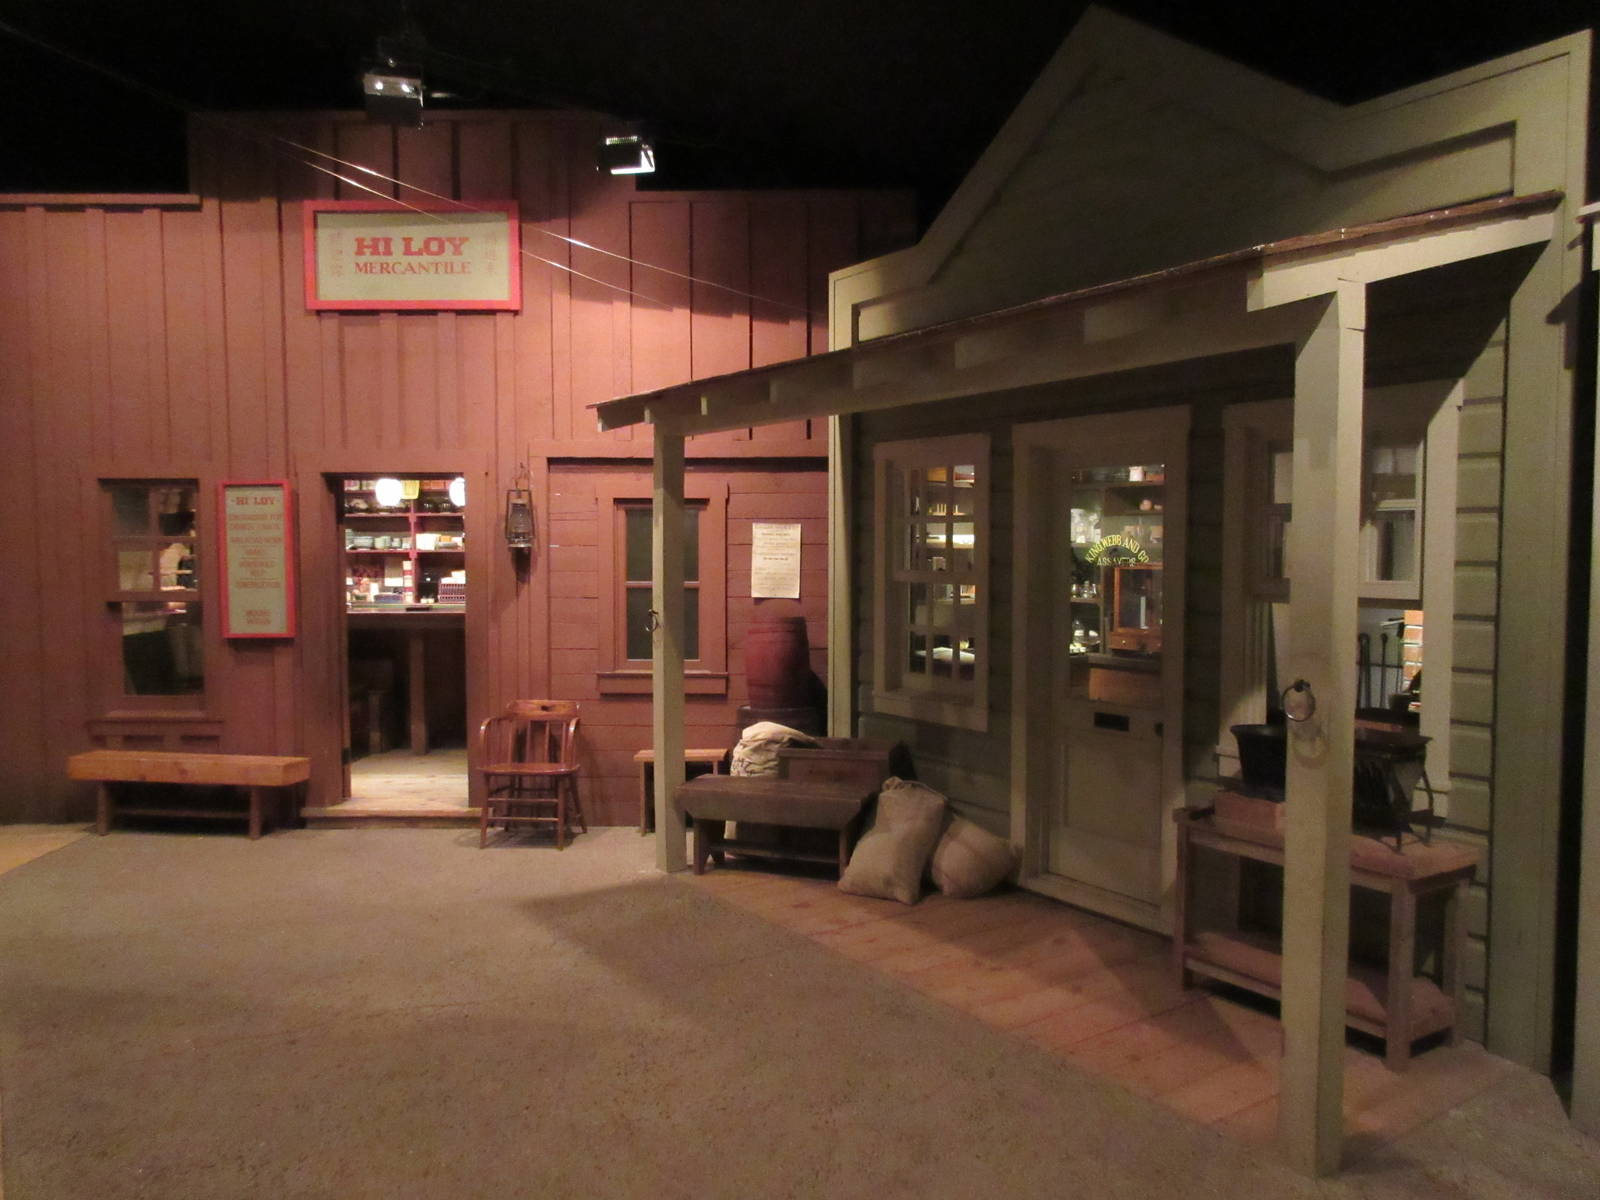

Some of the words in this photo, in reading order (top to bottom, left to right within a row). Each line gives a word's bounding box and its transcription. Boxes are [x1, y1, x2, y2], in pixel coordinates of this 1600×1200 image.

[354, 237, 393, 256] HI
[403, 237, 470, 256] LOY
[354, 261, 472, 275] MERCANTILE
[1121, 537, 1141, 554] AND
